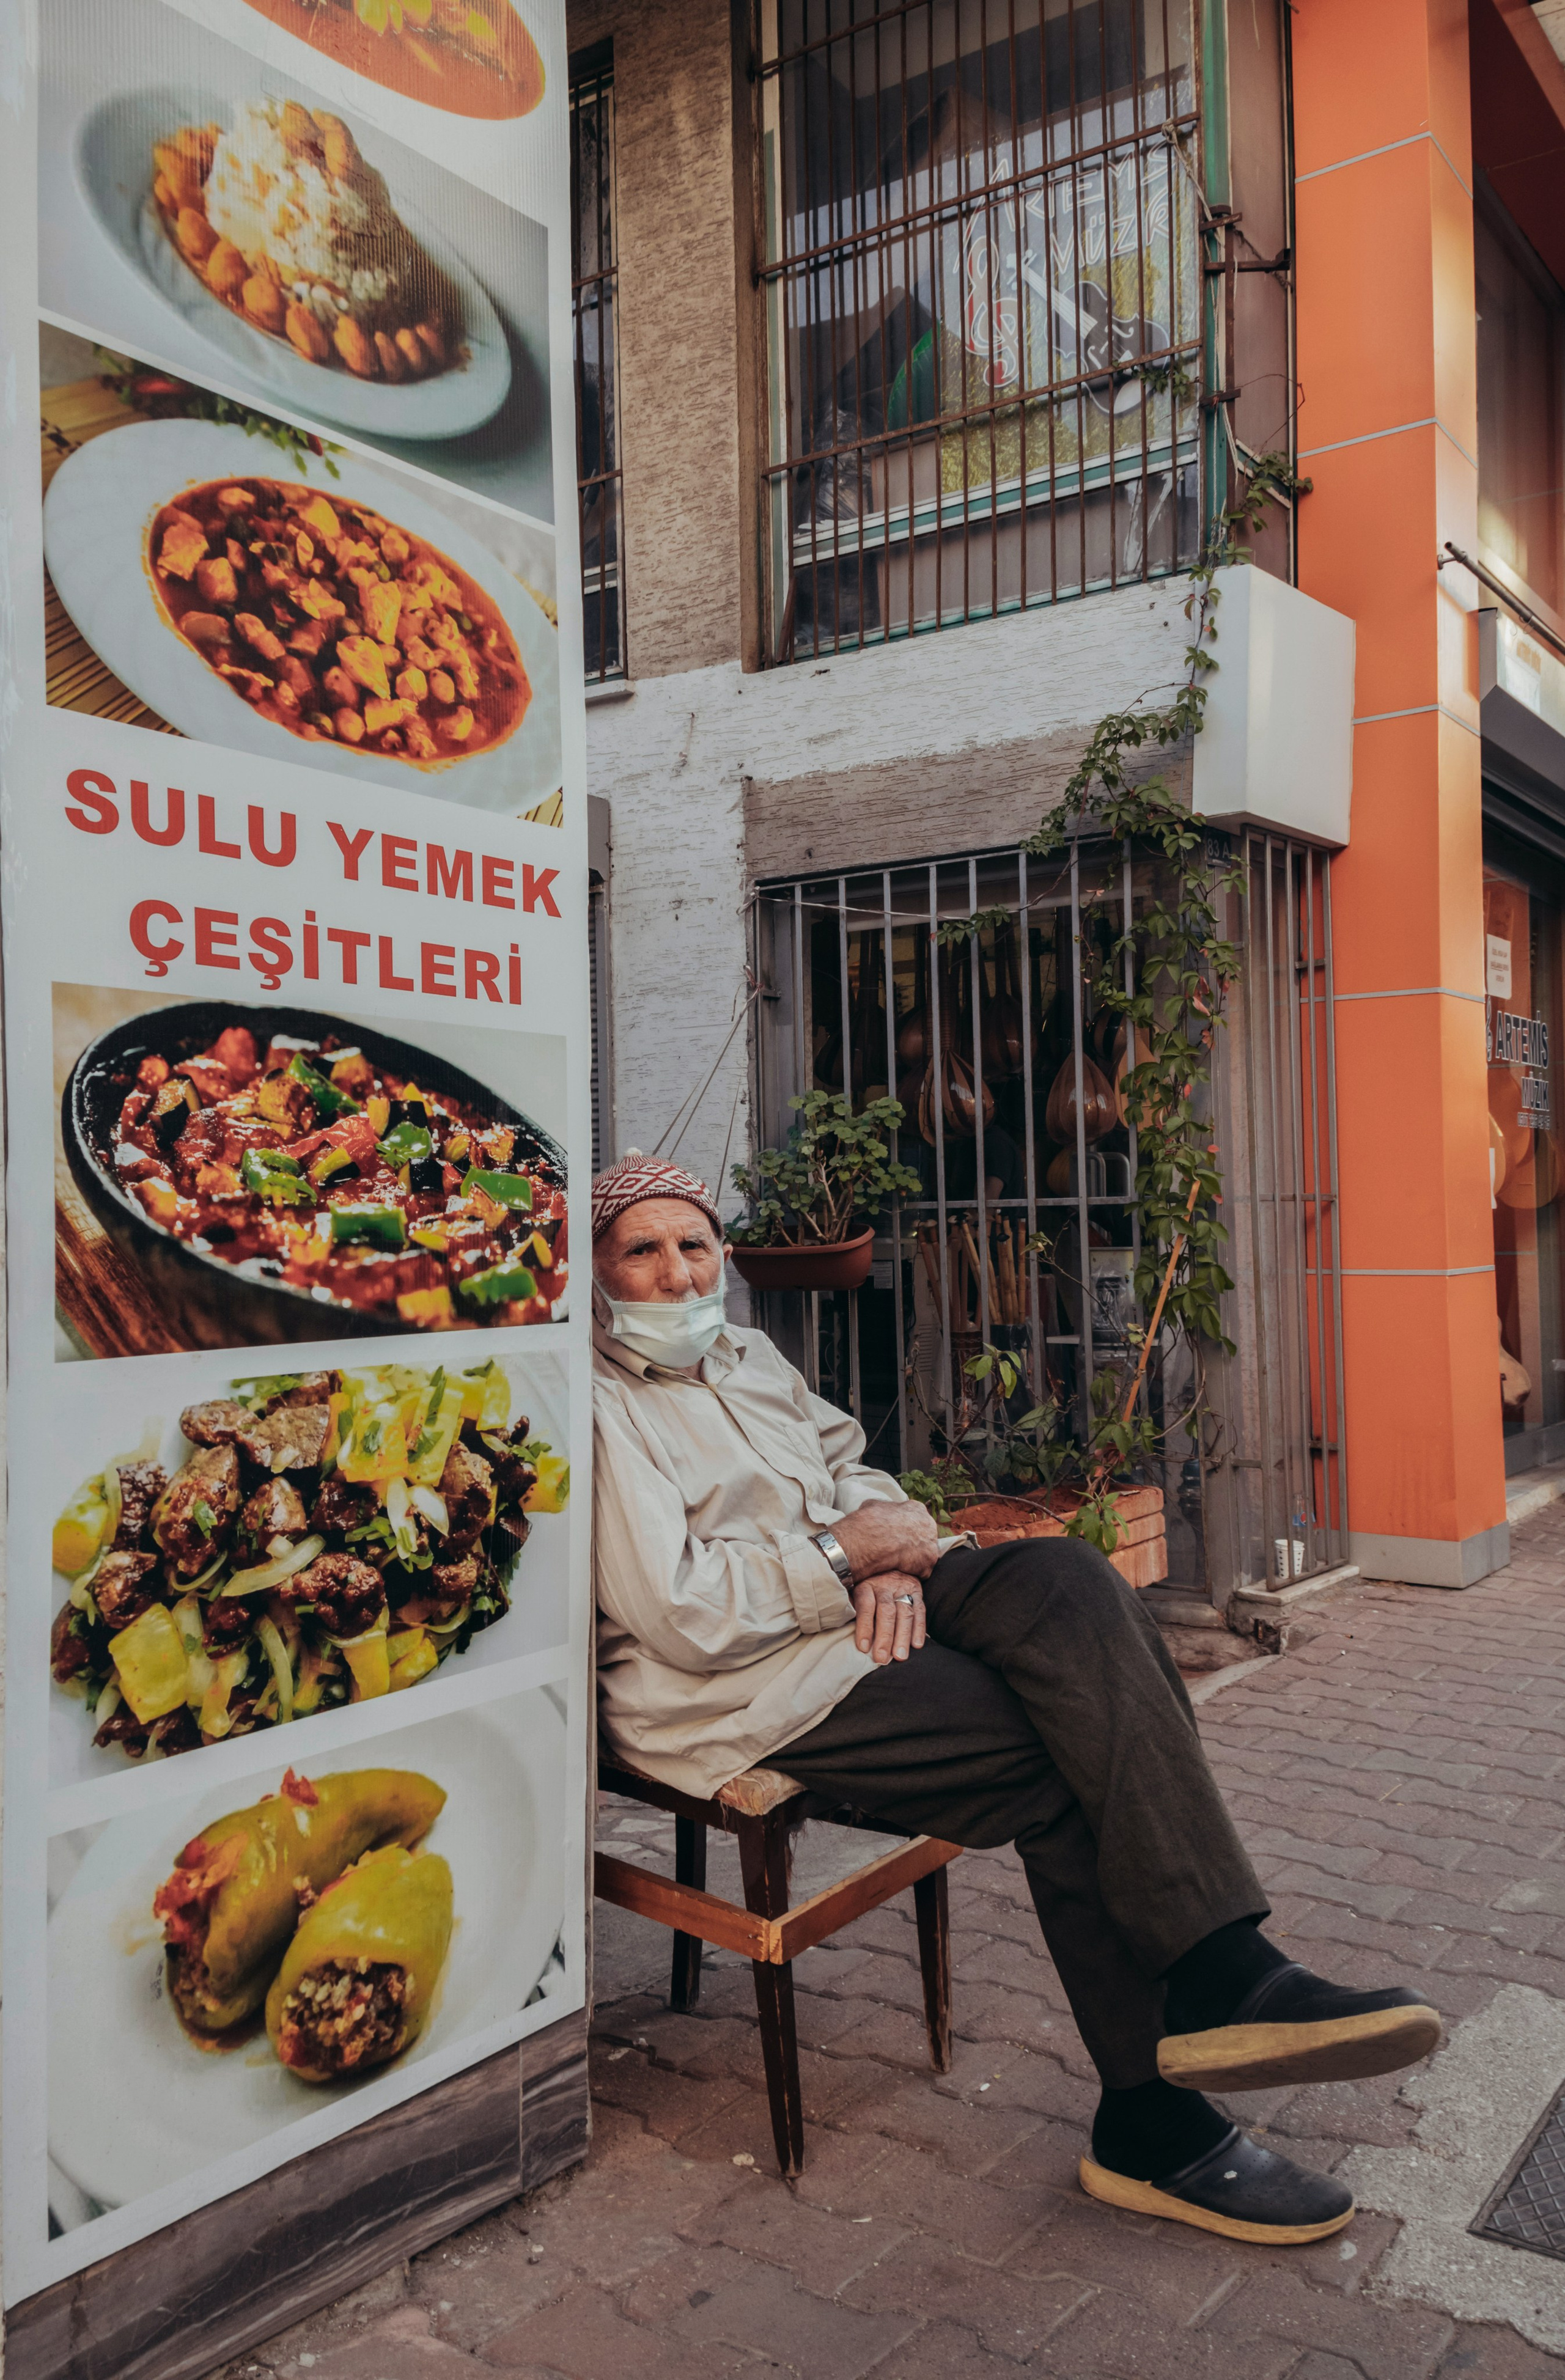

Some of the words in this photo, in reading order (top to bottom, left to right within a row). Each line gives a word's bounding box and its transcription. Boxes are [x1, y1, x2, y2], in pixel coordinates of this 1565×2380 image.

[953, 140, 1176, 274] ARTEMS
[1043, 186, 1171, 277] MÜZK
[64, 768, 297, 868] SULU
[326, 821, 562, 919] YEMEK
[129, 899, 522, 1005] ÇEŞİTLERİ
[1495, 1010, 1548, 1069] ARTEMİS
[1521, 1071, 1550, 1111] MÜZİK
